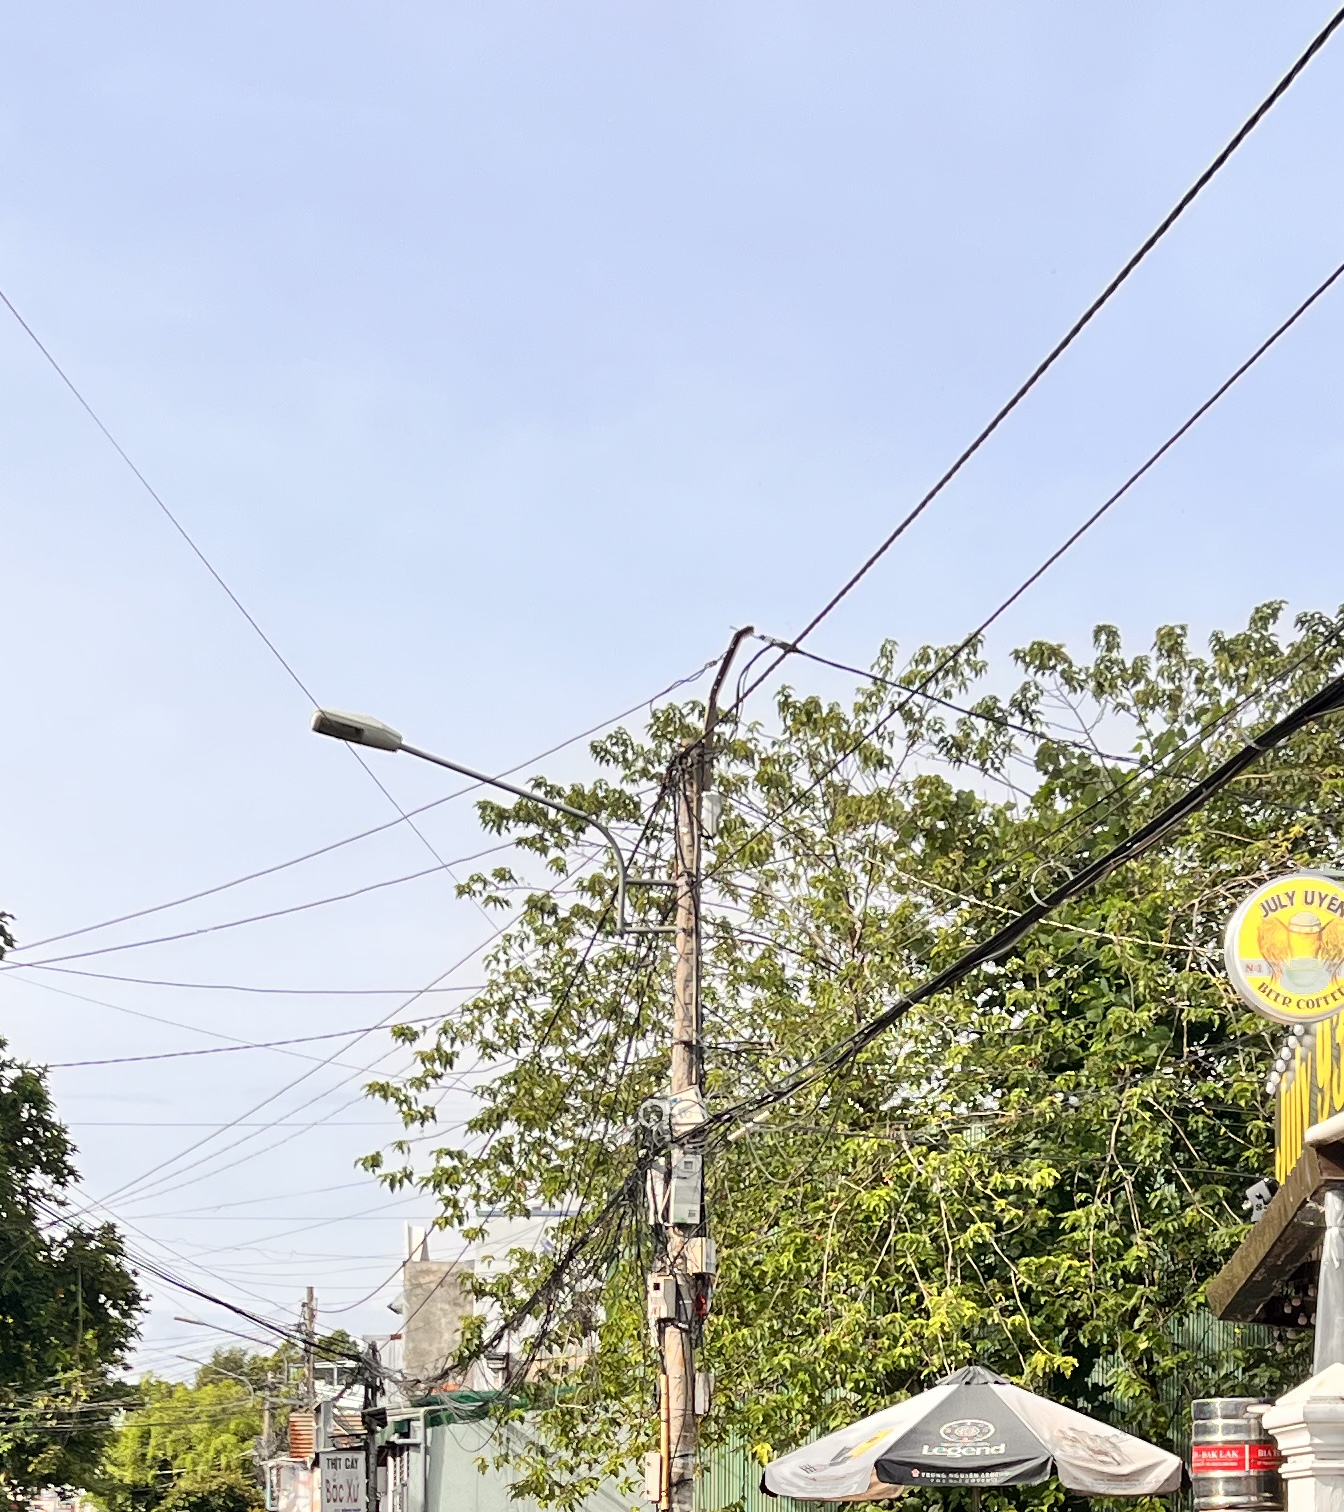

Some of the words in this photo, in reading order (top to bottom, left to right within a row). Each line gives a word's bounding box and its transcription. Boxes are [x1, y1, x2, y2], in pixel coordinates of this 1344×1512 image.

[1260, 890, 1296, 918] JULY
[1258, 982, 1292, 1007] BEER
[922, 1443, 1006, 1457] Legend
